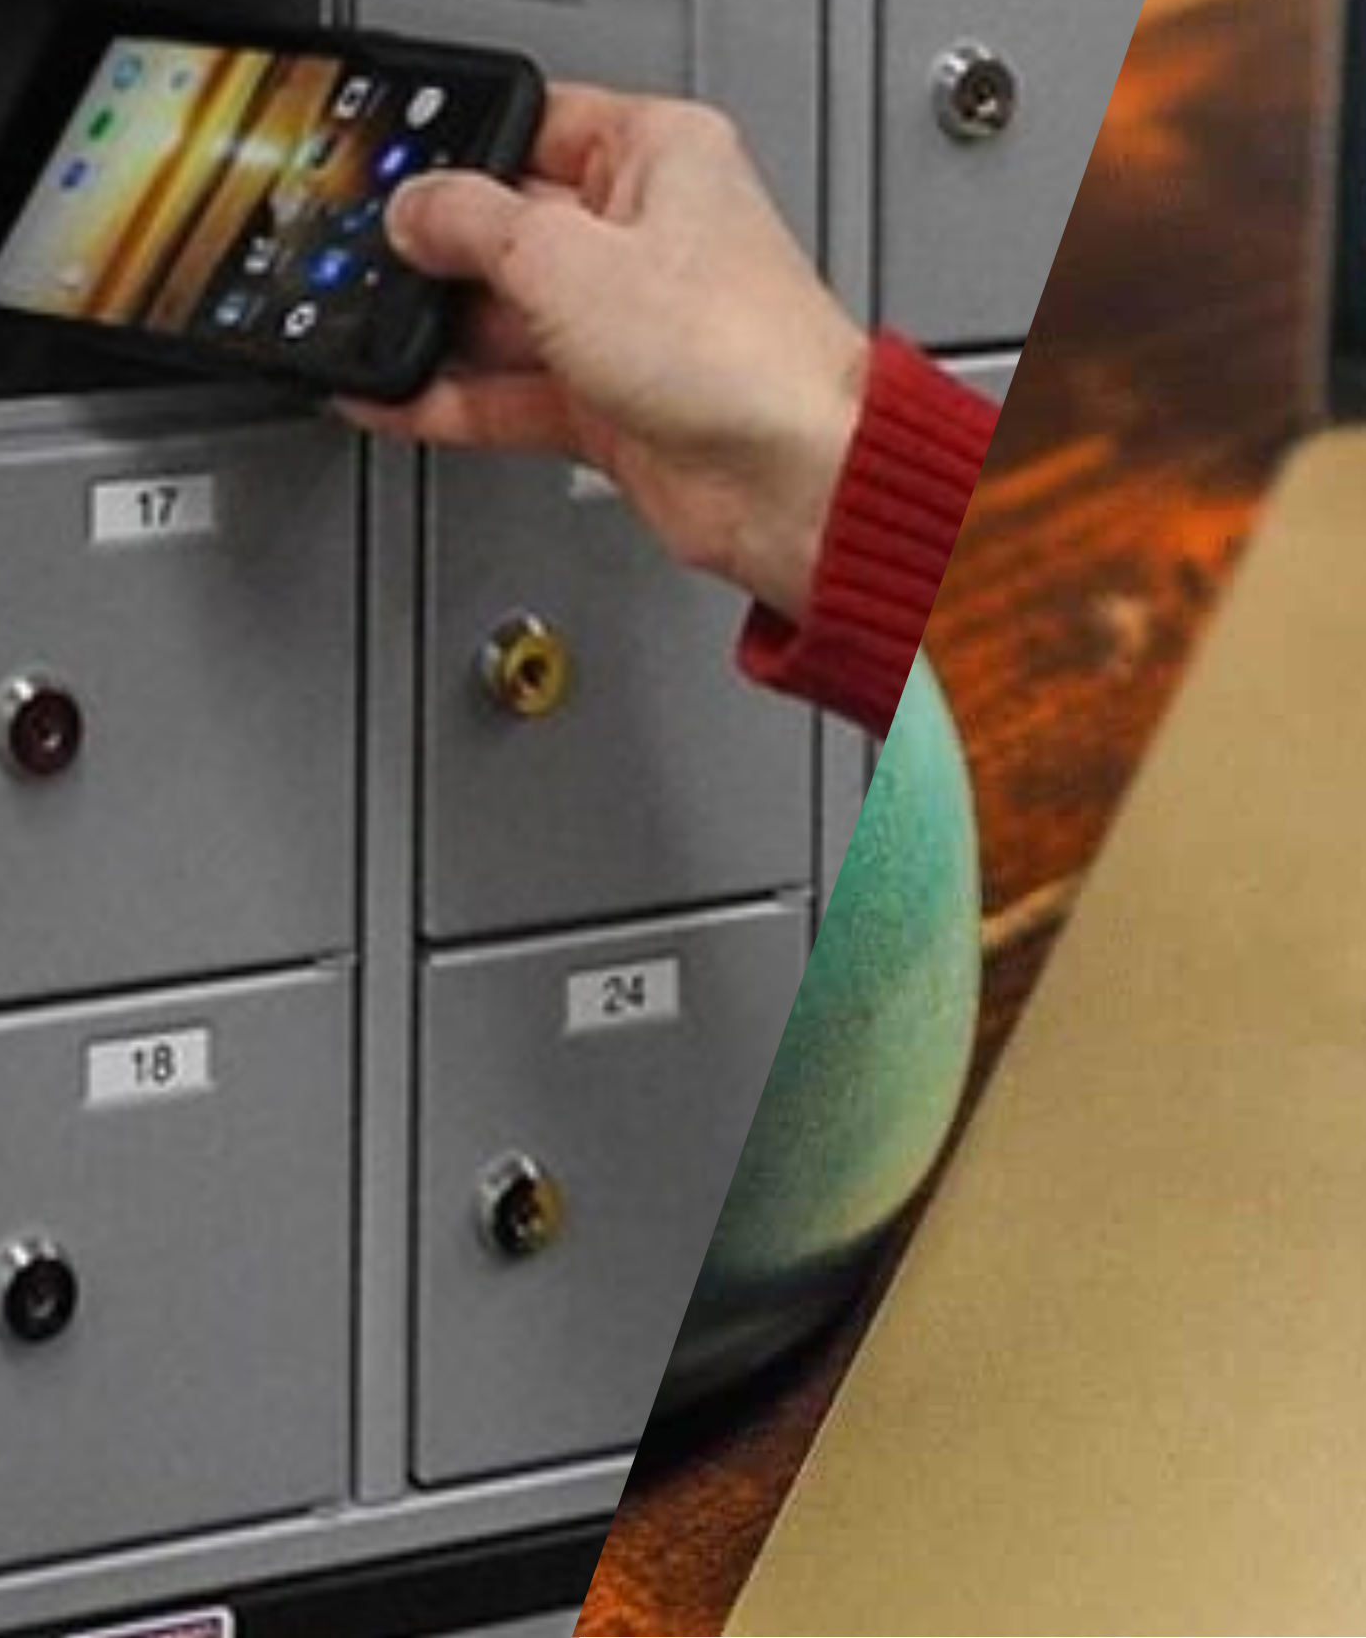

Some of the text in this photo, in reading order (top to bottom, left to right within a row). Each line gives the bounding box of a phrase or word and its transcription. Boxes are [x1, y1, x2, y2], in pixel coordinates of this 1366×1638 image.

[137, 484, 178, 528] 17
[603, 975, 645, 1015] 24
[133, 1043, 175, 1085] 18
